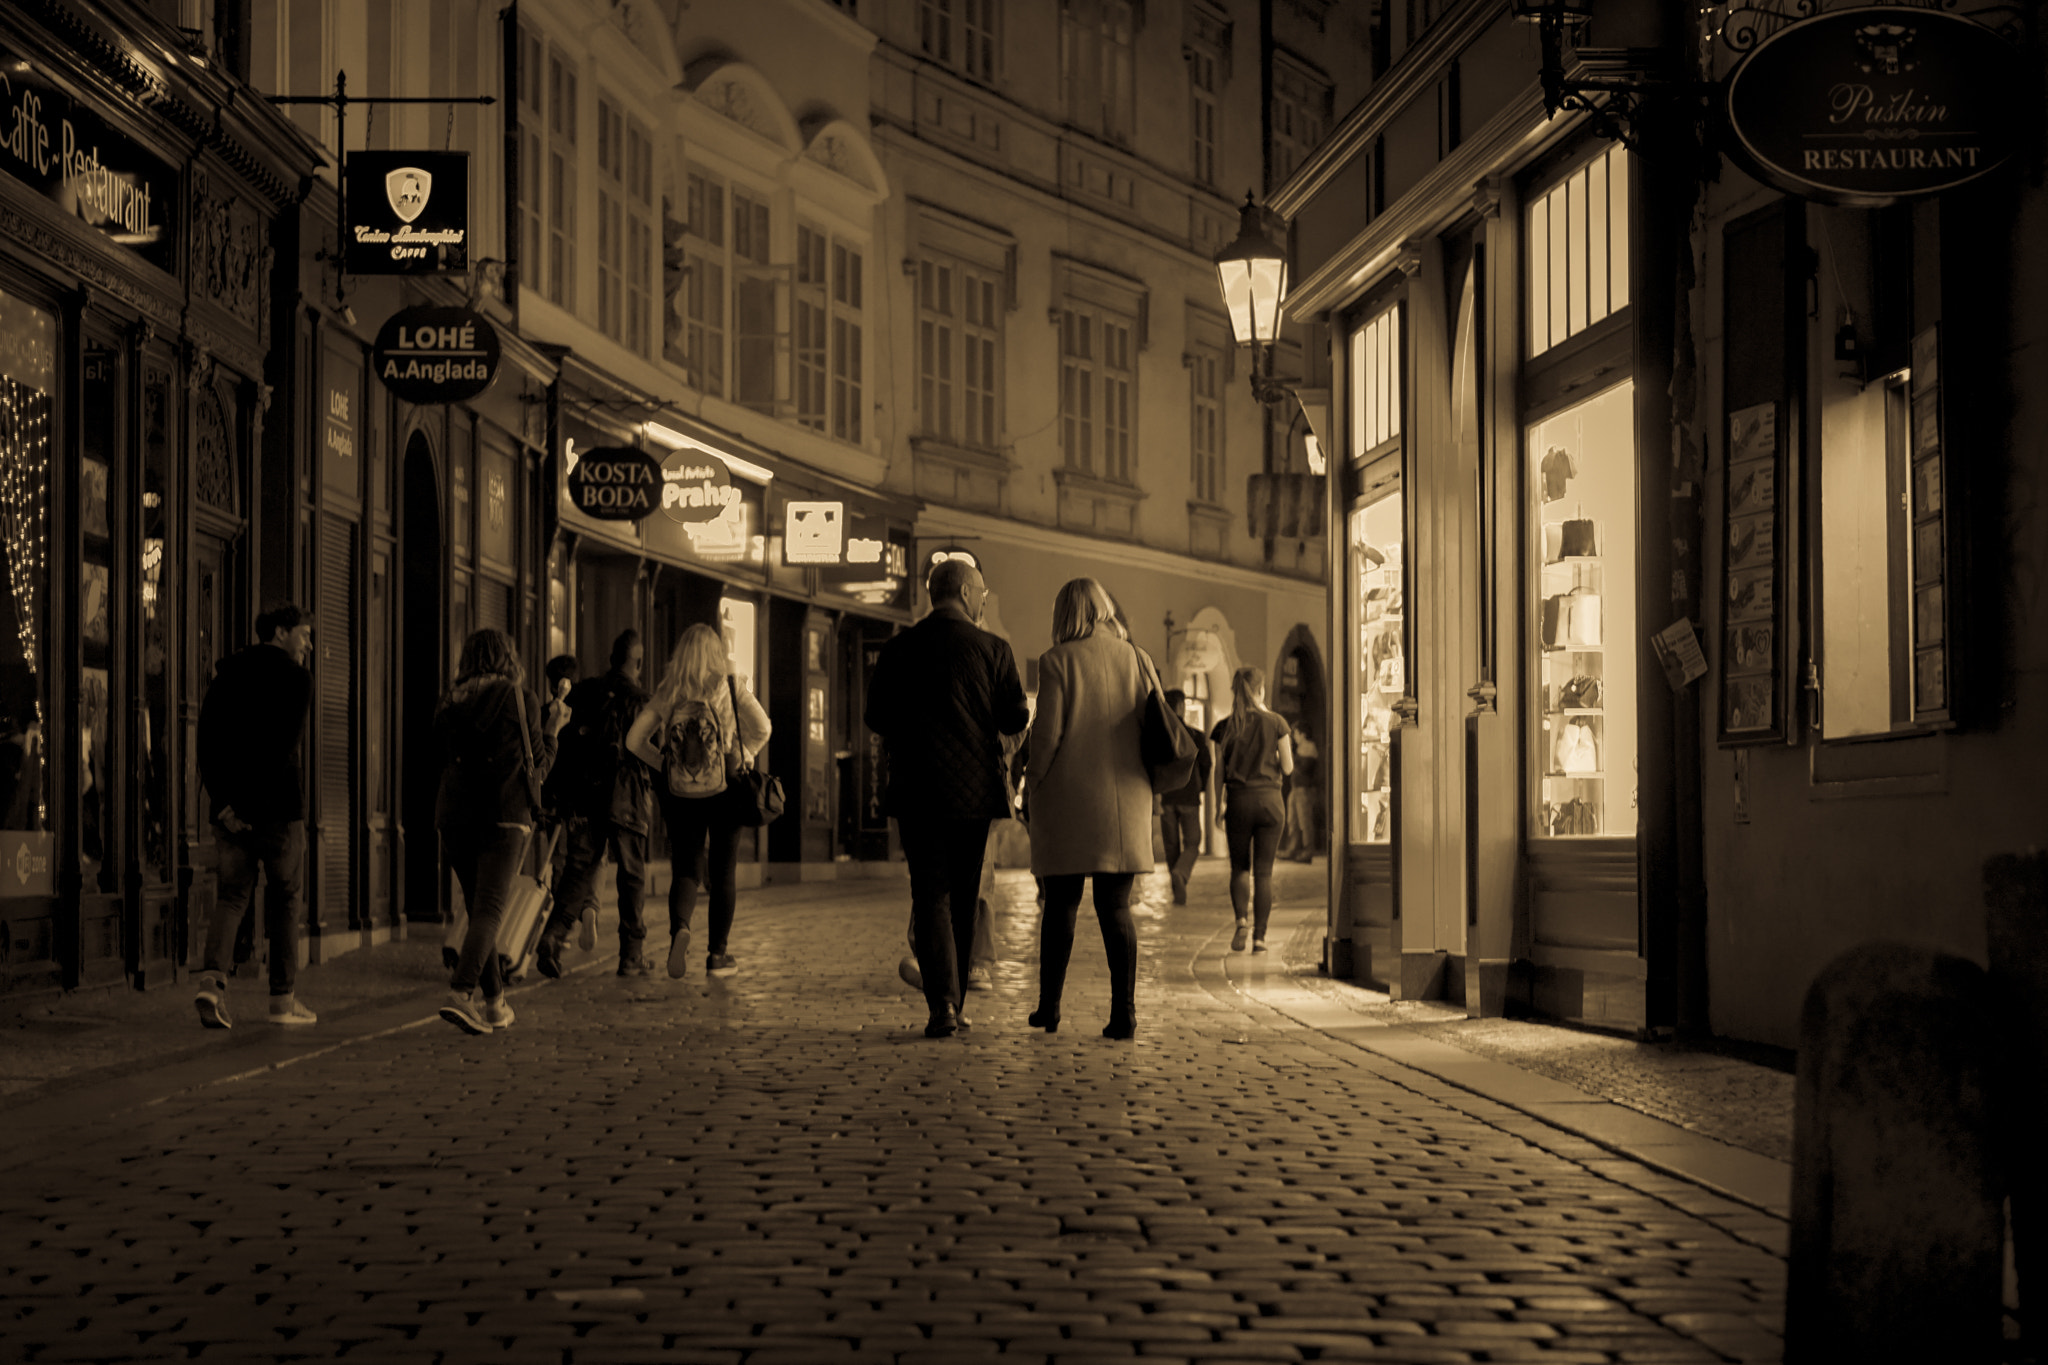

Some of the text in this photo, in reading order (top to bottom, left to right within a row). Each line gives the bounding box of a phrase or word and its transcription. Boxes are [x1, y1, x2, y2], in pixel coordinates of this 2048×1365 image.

[1828, 82, 1949, 124] Puškin
[1804, 147, 1980, 170] RESTAURANT
[62, 117, 151, 236] Restaurant
[398, 319, 476, 350] LOHÉ
[383, 358, 488, 384] A.Anglada
[579, 462, 654, 484] KOSTA
[583, 485, 650, 508] BODA
